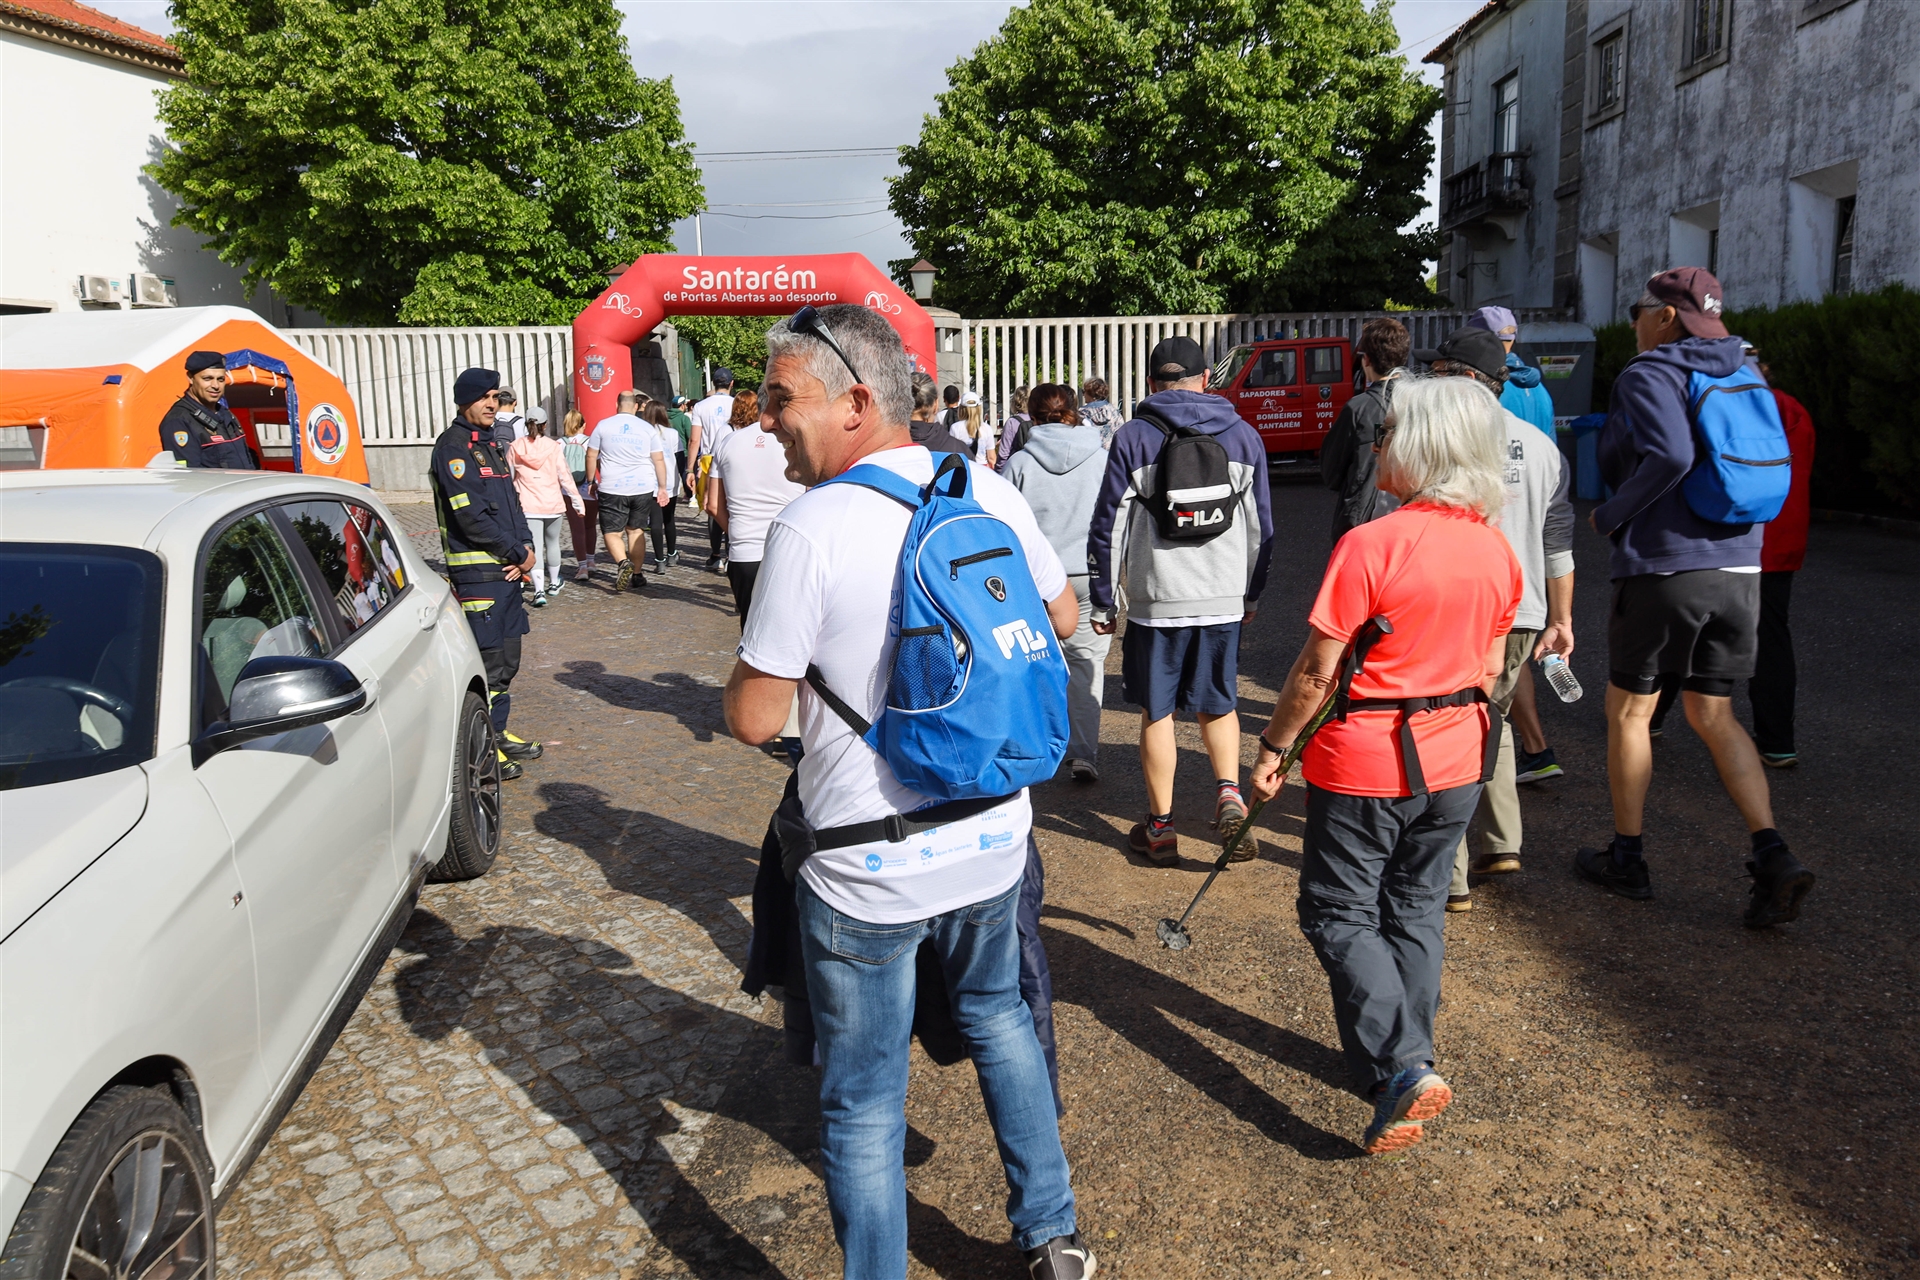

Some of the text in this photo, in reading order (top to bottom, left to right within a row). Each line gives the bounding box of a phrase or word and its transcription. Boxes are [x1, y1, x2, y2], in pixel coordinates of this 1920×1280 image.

[682, 264, 816, 290] Santarém
[663, 290, 837, 304] de Portas Abertas ao desporto
[1239, 389, 1286, 399] SAPADORES
[1316, 401, 1333, 409] 1401
[1256, 411, 1302, 421] BOMBEIROS
[1315, 411, 1334, 419] VOPE
[1258, 420, 1301, 430] SANTARÉM
[1177, 507, 1225, 528] FILA
